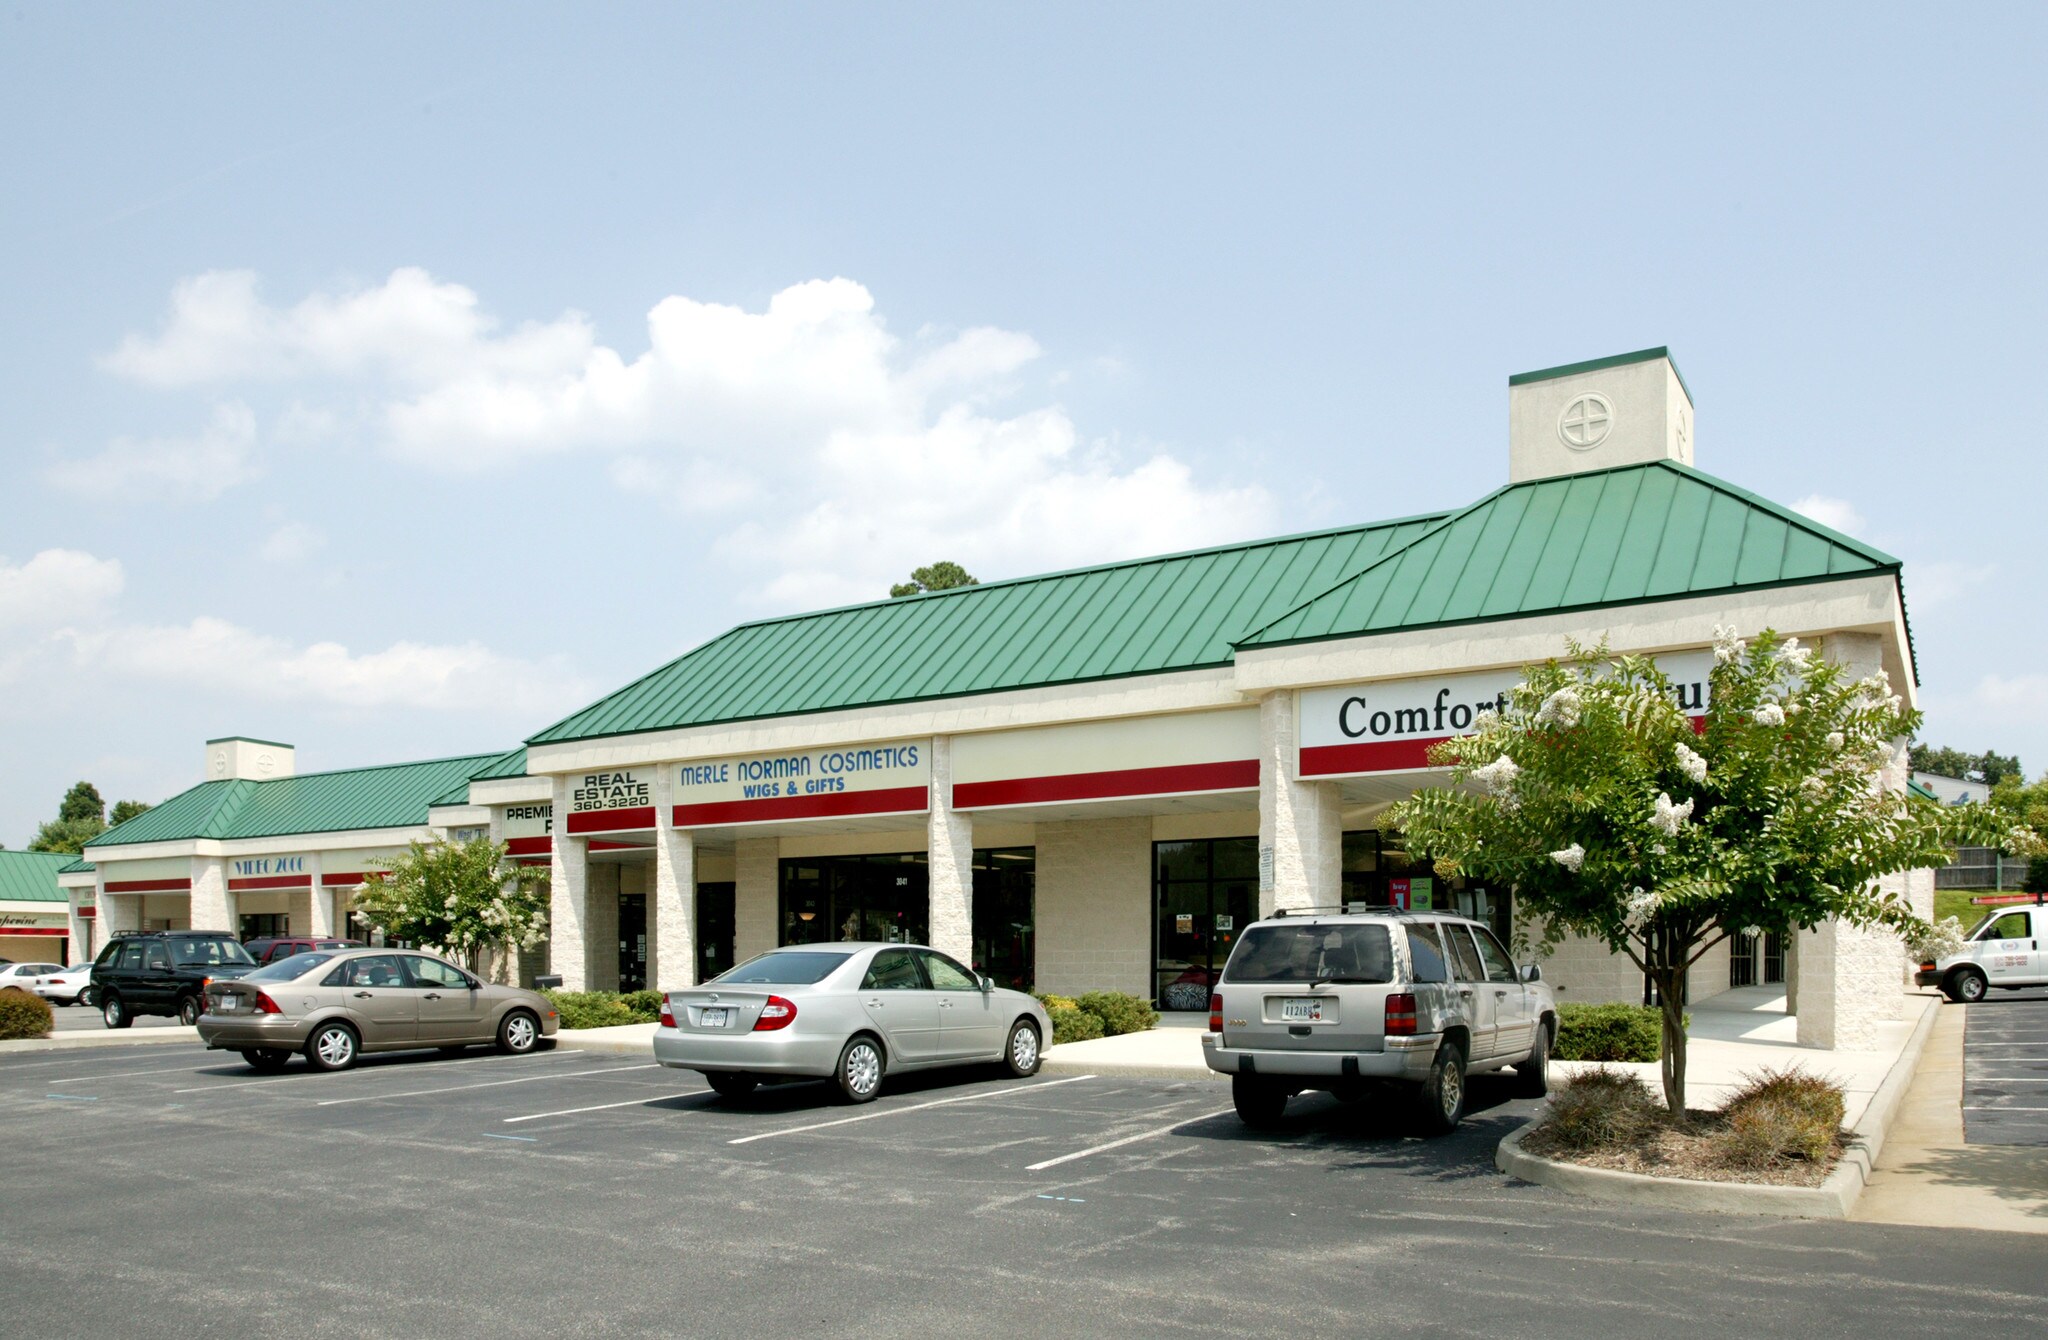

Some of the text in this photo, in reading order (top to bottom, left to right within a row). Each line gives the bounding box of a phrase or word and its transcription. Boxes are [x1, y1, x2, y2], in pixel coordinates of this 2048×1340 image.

[681, 745, 918, 786] MERLE NORMAN COSMETICS
[585, 772, 637, 787] REAL
[743, 777, 845, 799] WIGS & GIFTS
[574, 783, 649, 801] ESTATE
[574, 796, 649, 811] 360-3220
[235, 856, 305, 875] VIDEO 2000
